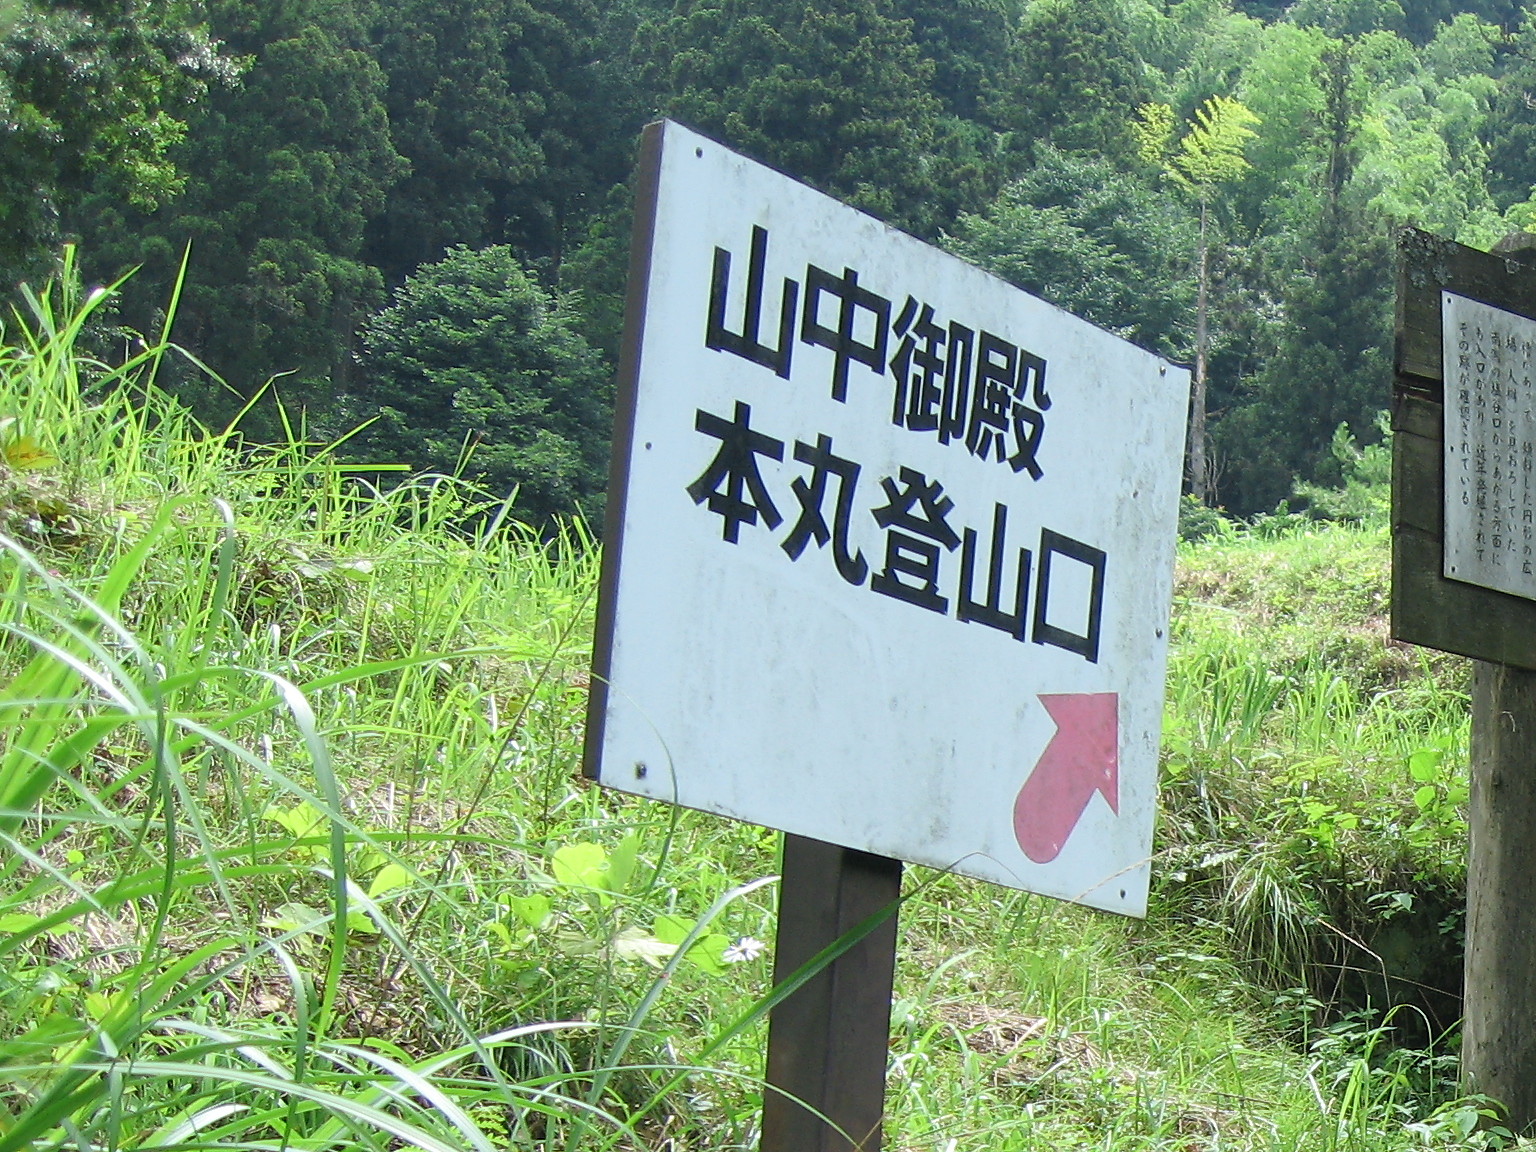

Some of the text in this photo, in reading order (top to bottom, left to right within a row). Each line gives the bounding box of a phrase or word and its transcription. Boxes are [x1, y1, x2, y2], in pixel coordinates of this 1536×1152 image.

[705, 225, 1051, 481] 山中御殿
[687, 402, 1107, 663] 本丸登山口
